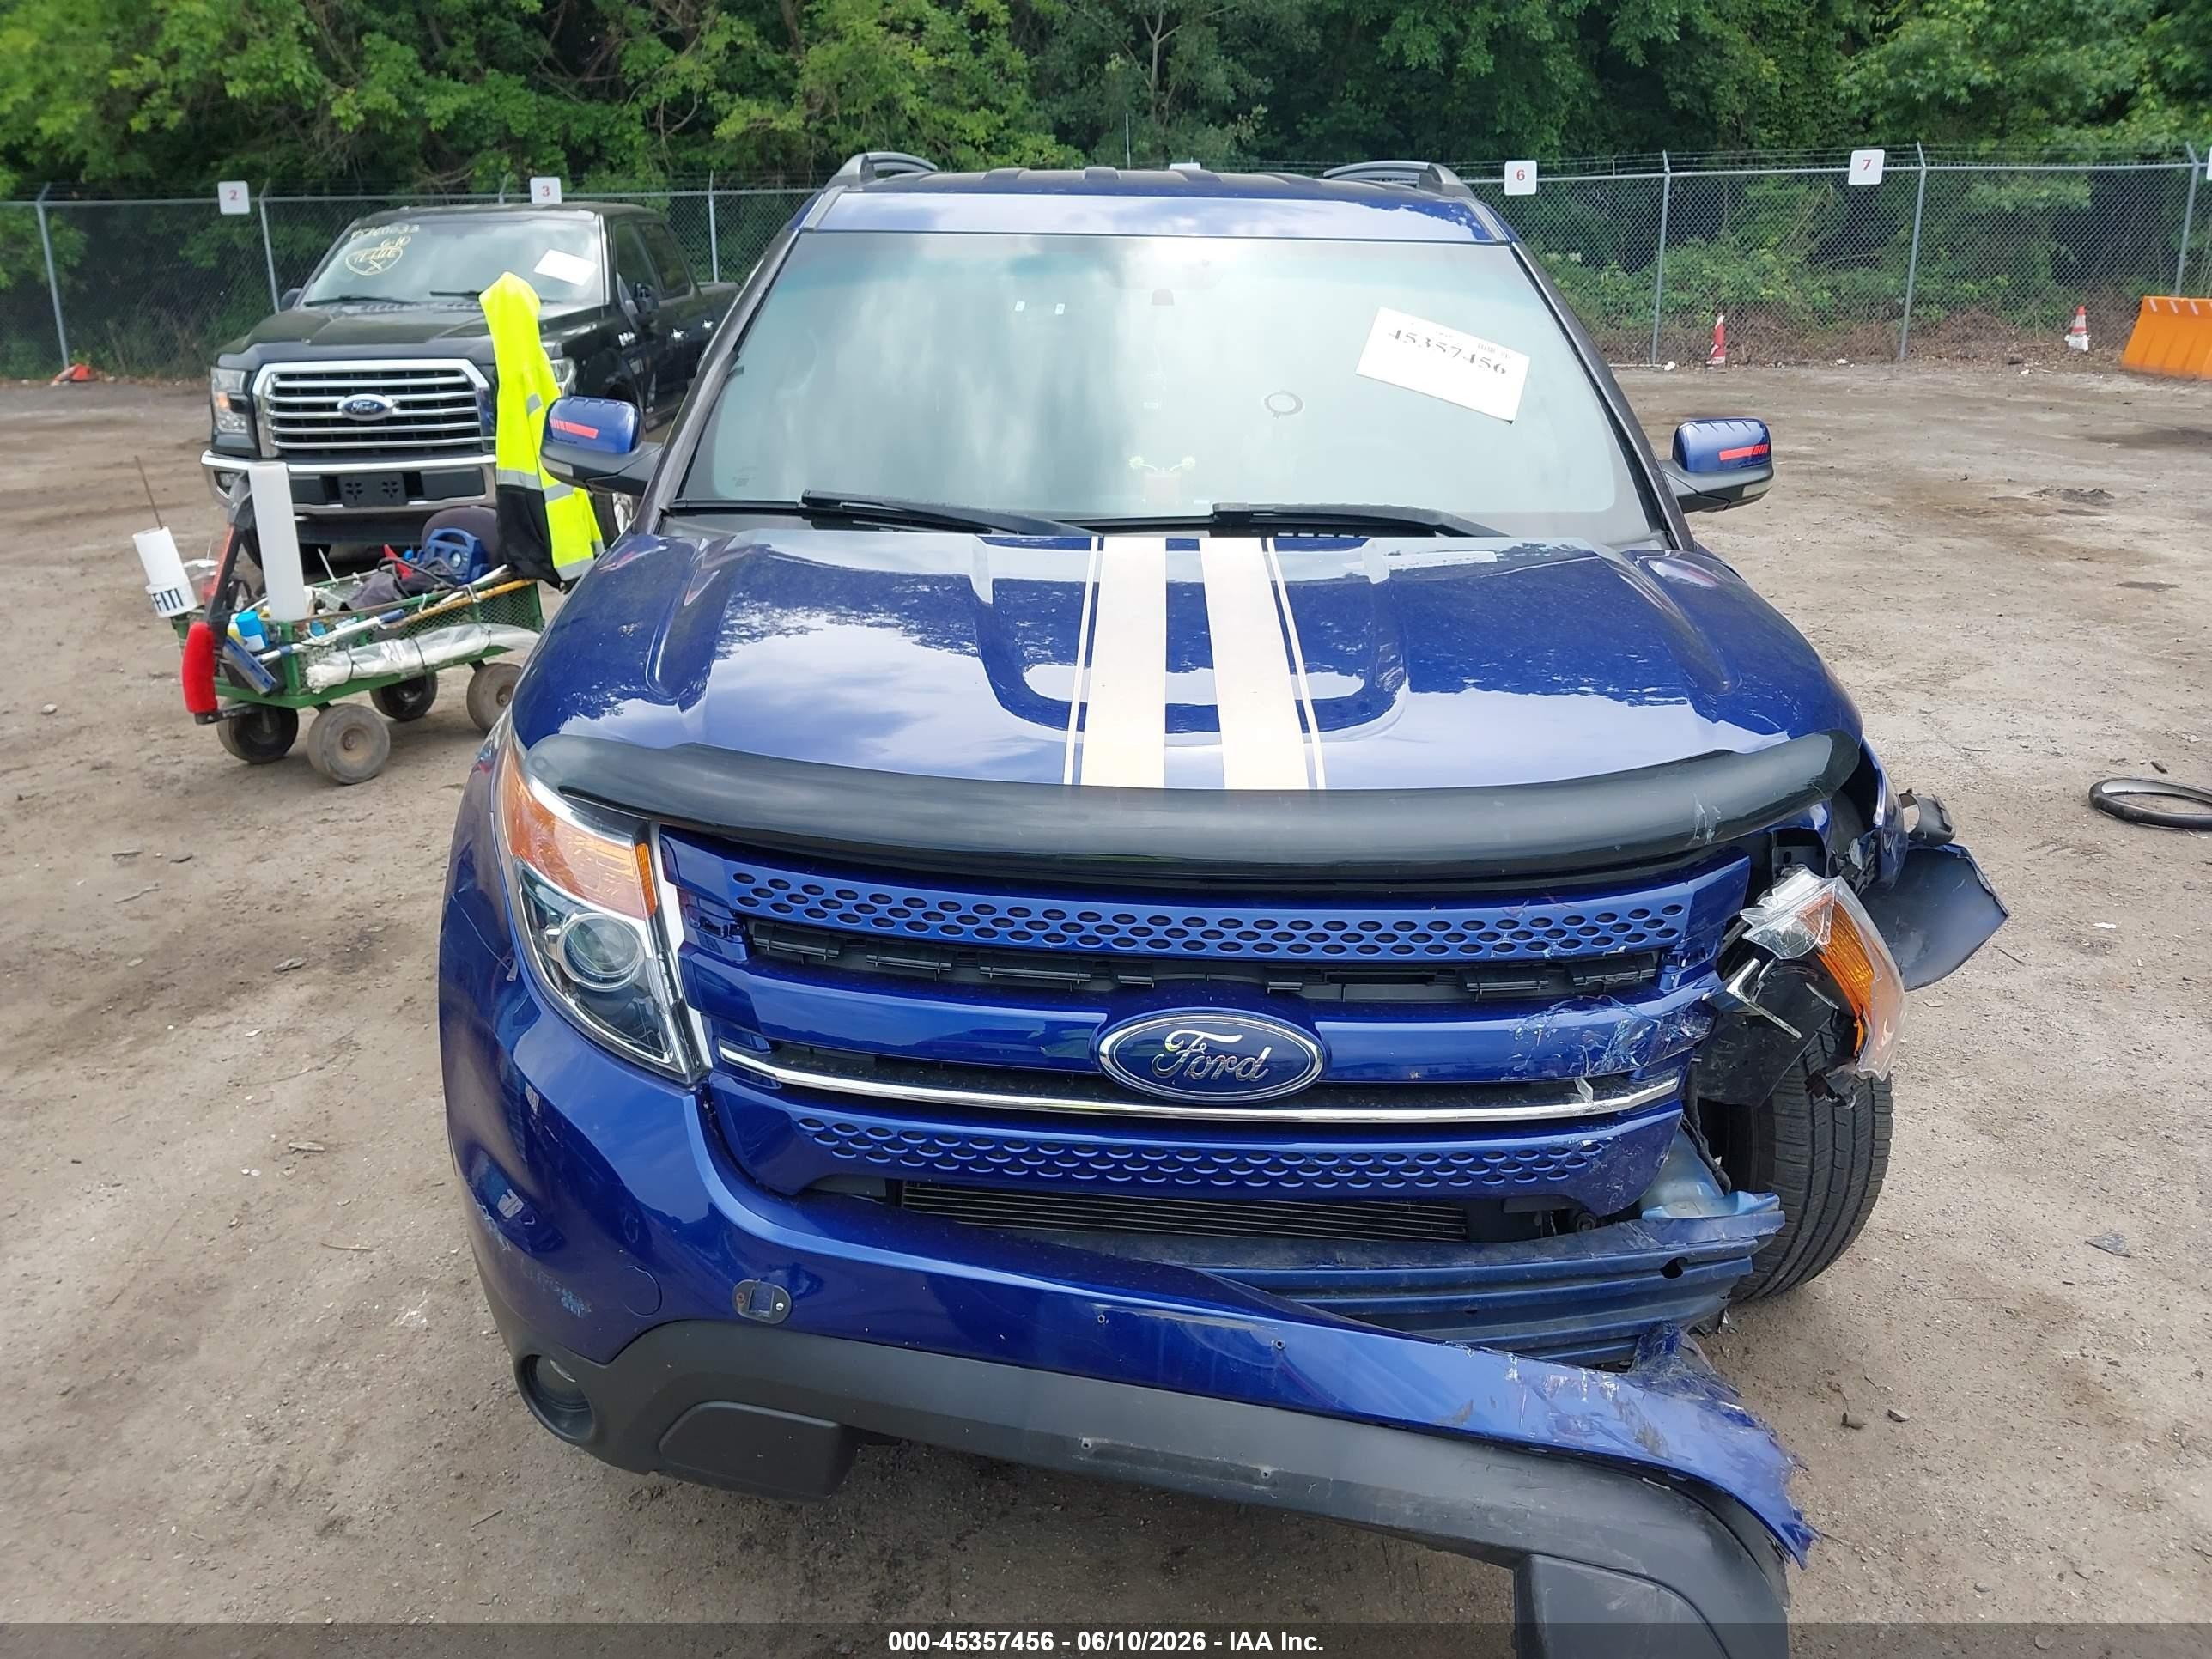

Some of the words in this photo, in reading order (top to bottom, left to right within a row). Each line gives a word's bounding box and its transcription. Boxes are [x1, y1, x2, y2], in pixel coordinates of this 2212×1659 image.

[1862, 158, 1872, 172] 7
[1516, 168, 1526, 182] 6
[228, 188, 240, 202] 2
[542, 185, 550, 198] 3
[1387, 329, 1507, 375] 45357456
[350, 401, 379, 414] Ford
[1151, 1030, 1273, 1083] Ford
